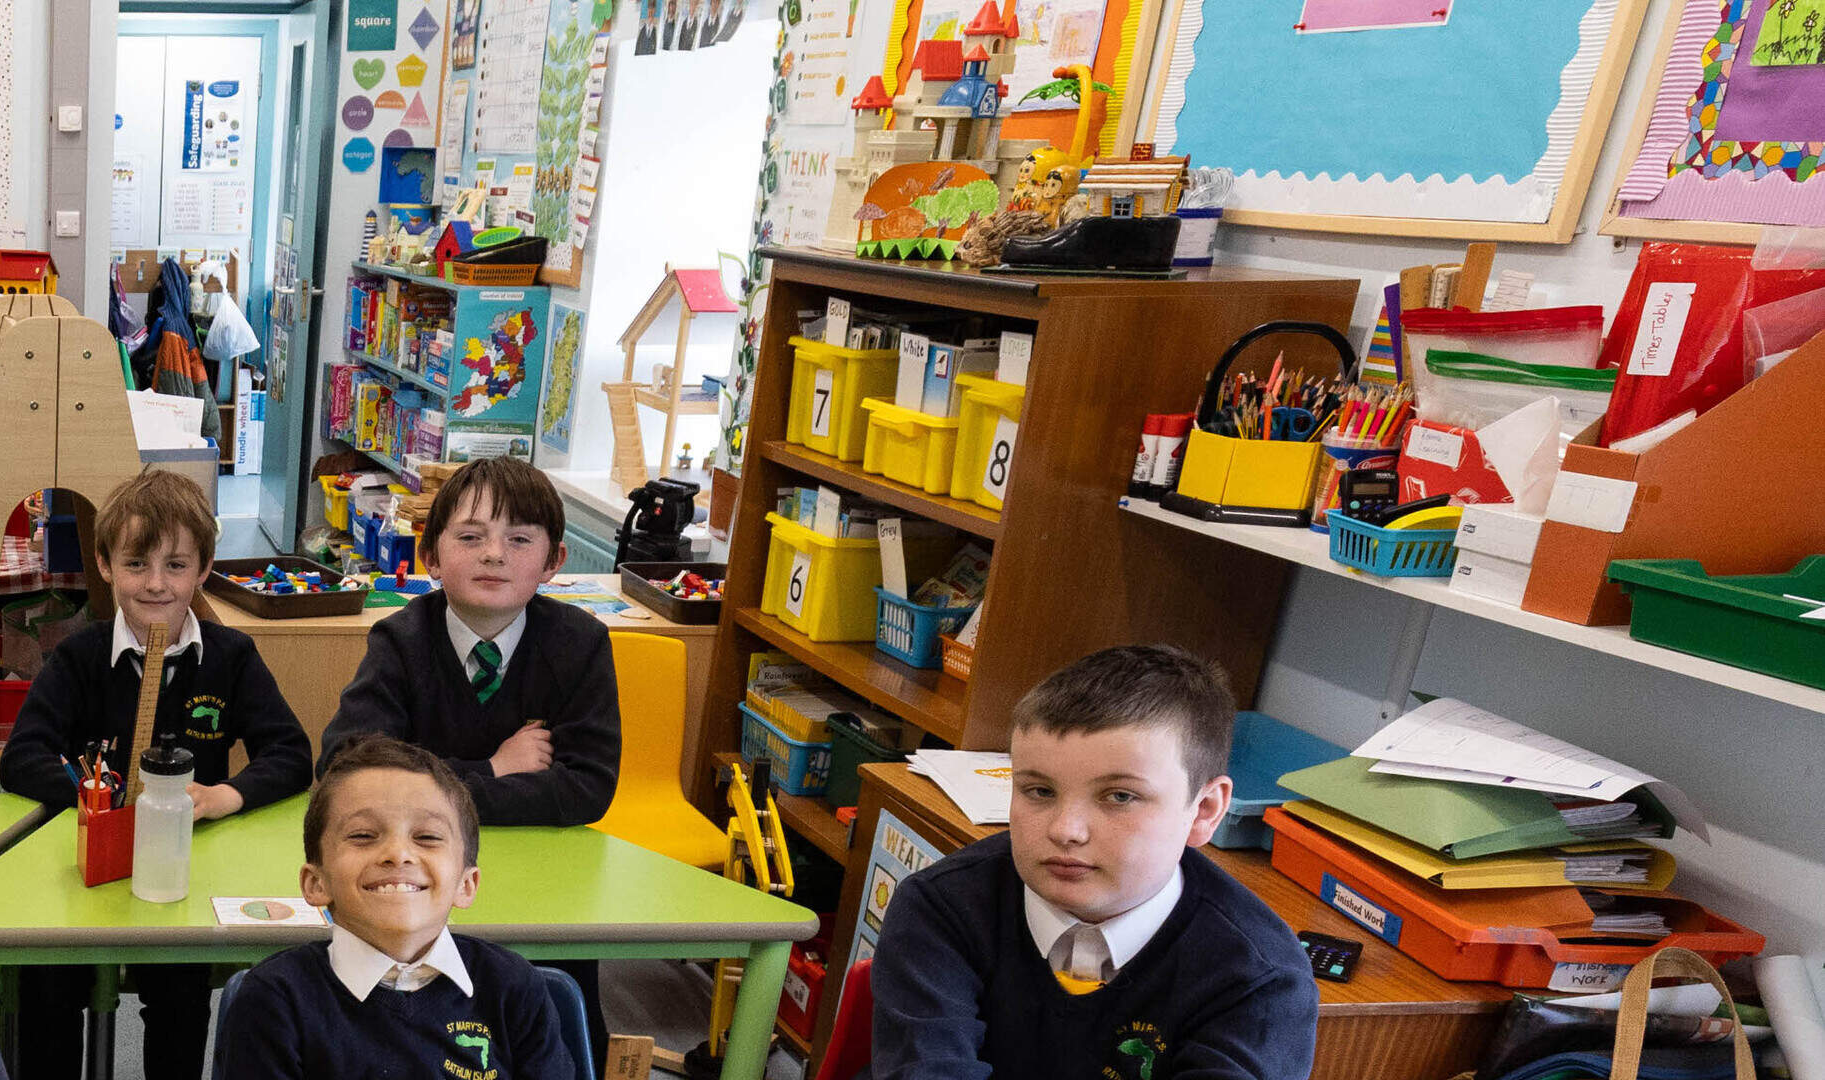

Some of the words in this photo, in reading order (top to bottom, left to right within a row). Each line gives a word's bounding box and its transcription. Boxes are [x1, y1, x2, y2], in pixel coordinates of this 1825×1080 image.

[354, 15, 392, 28] square
[188, 94, 203, 168] Safeguarding
[784, 151, 831, 177] THINK
[1638, 336, 1662, 370] Times
[1651, 292, 1674, 334] Tables
[902, 338, 925, 358] White
[237, 402, 248, 430] wheel
[815, 389, 830, 428] 7
[237, 431, 247, 465] trundle
[989, 439, 1011, 487] 8
[879, 523, 898, 541] Grey
[790, 565, 803, 603] 6
[1333, 888, 1363, 916] Finished
[1363, 907, 1387, 929] Work
[446, 1022, 455, 1033] ST
[455, 1021, 483, 1033] MARY'S
[443, 1059, 472, 1080] RATHLIN
